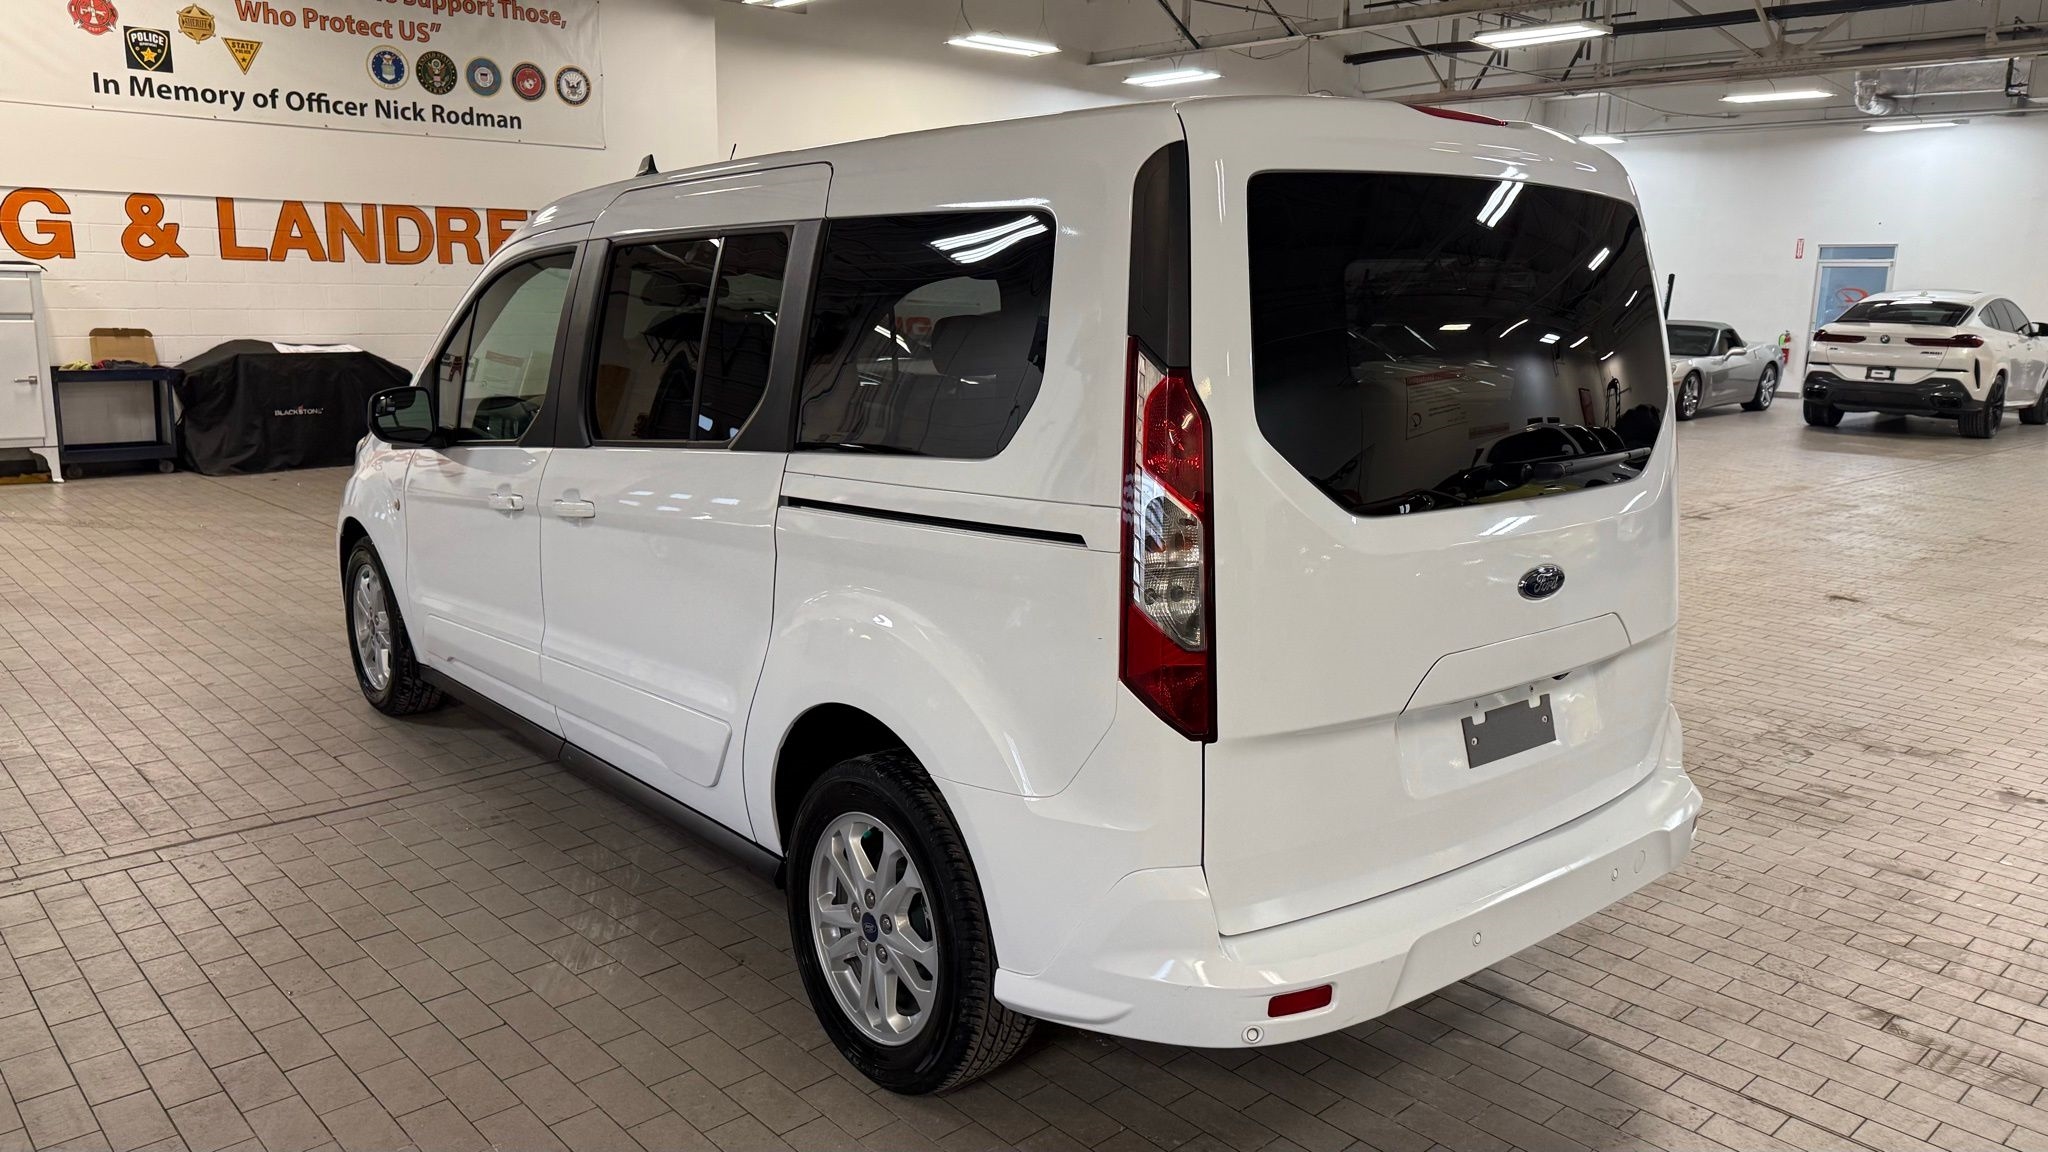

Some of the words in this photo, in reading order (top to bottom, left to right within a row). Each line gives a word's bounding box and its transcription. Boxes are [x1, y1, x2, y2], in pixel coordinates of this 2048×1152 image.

[235, 0, 297, 27] Who
[302, 7, 393, 39] Protect
[404, 0, 495, 17] upport
[498, 0, 566, 29] Those,
[131, 31, 164, 46] POLICE
[231, 41, 254, 50] STATE
[92, 72, 121, 95] In
[129, 75, 246, 112] Memory
[252, 88, 279, 109] of
[285, 91, 369, 118] Officer
[375, 99, 427, 123] Nick
[432, 104, 522, 130] Rodman
[0, 187, 76, 260] G
[121, 193, 190, 261] &
[216, 197, 538, 265] LANDRE
